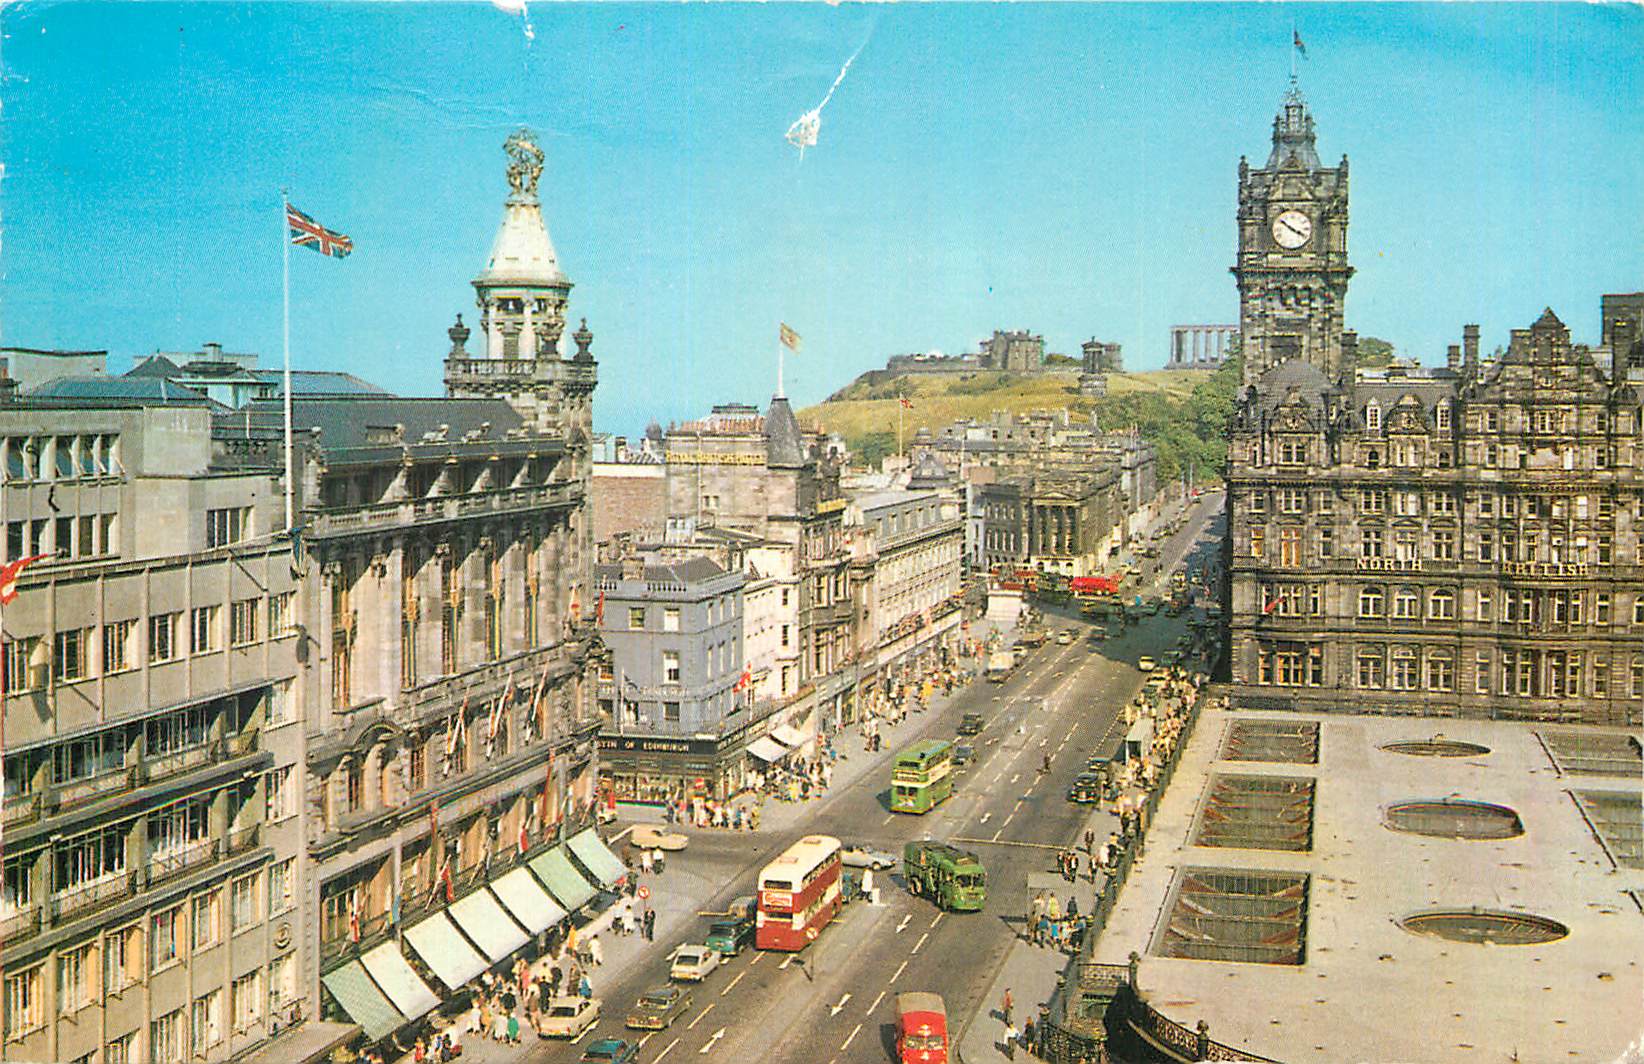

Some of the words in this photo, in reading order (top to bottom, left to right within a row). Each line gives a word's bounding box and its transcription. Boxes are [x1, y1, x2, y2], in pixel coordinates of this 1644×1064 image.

[1356, 557, 1422, 571] NORTH
[1504, 560, 1588, 576] BRITISH
[624, 741, 635, 750] OF
[643, 742, 689, 753] EDINBURGH
